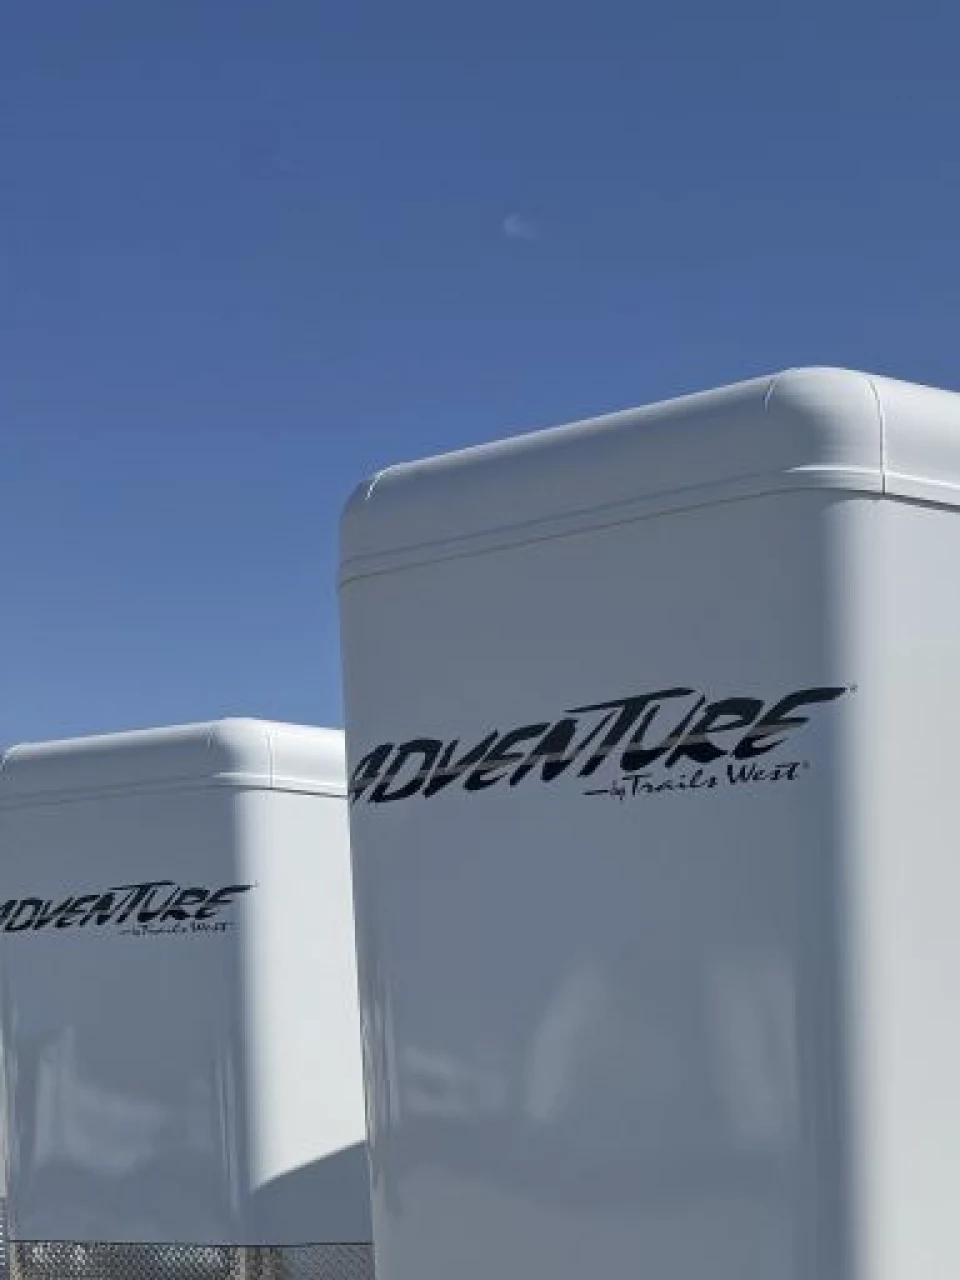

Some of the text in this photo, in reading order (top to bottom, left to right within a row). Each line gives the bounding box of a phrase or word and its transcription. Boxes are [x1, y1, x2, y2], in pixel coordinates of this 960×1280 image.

[349, 687, 846, 804] ADVENTURE
[622, 768, 718, 796] Trails
[727, 761, 801, 786] West
